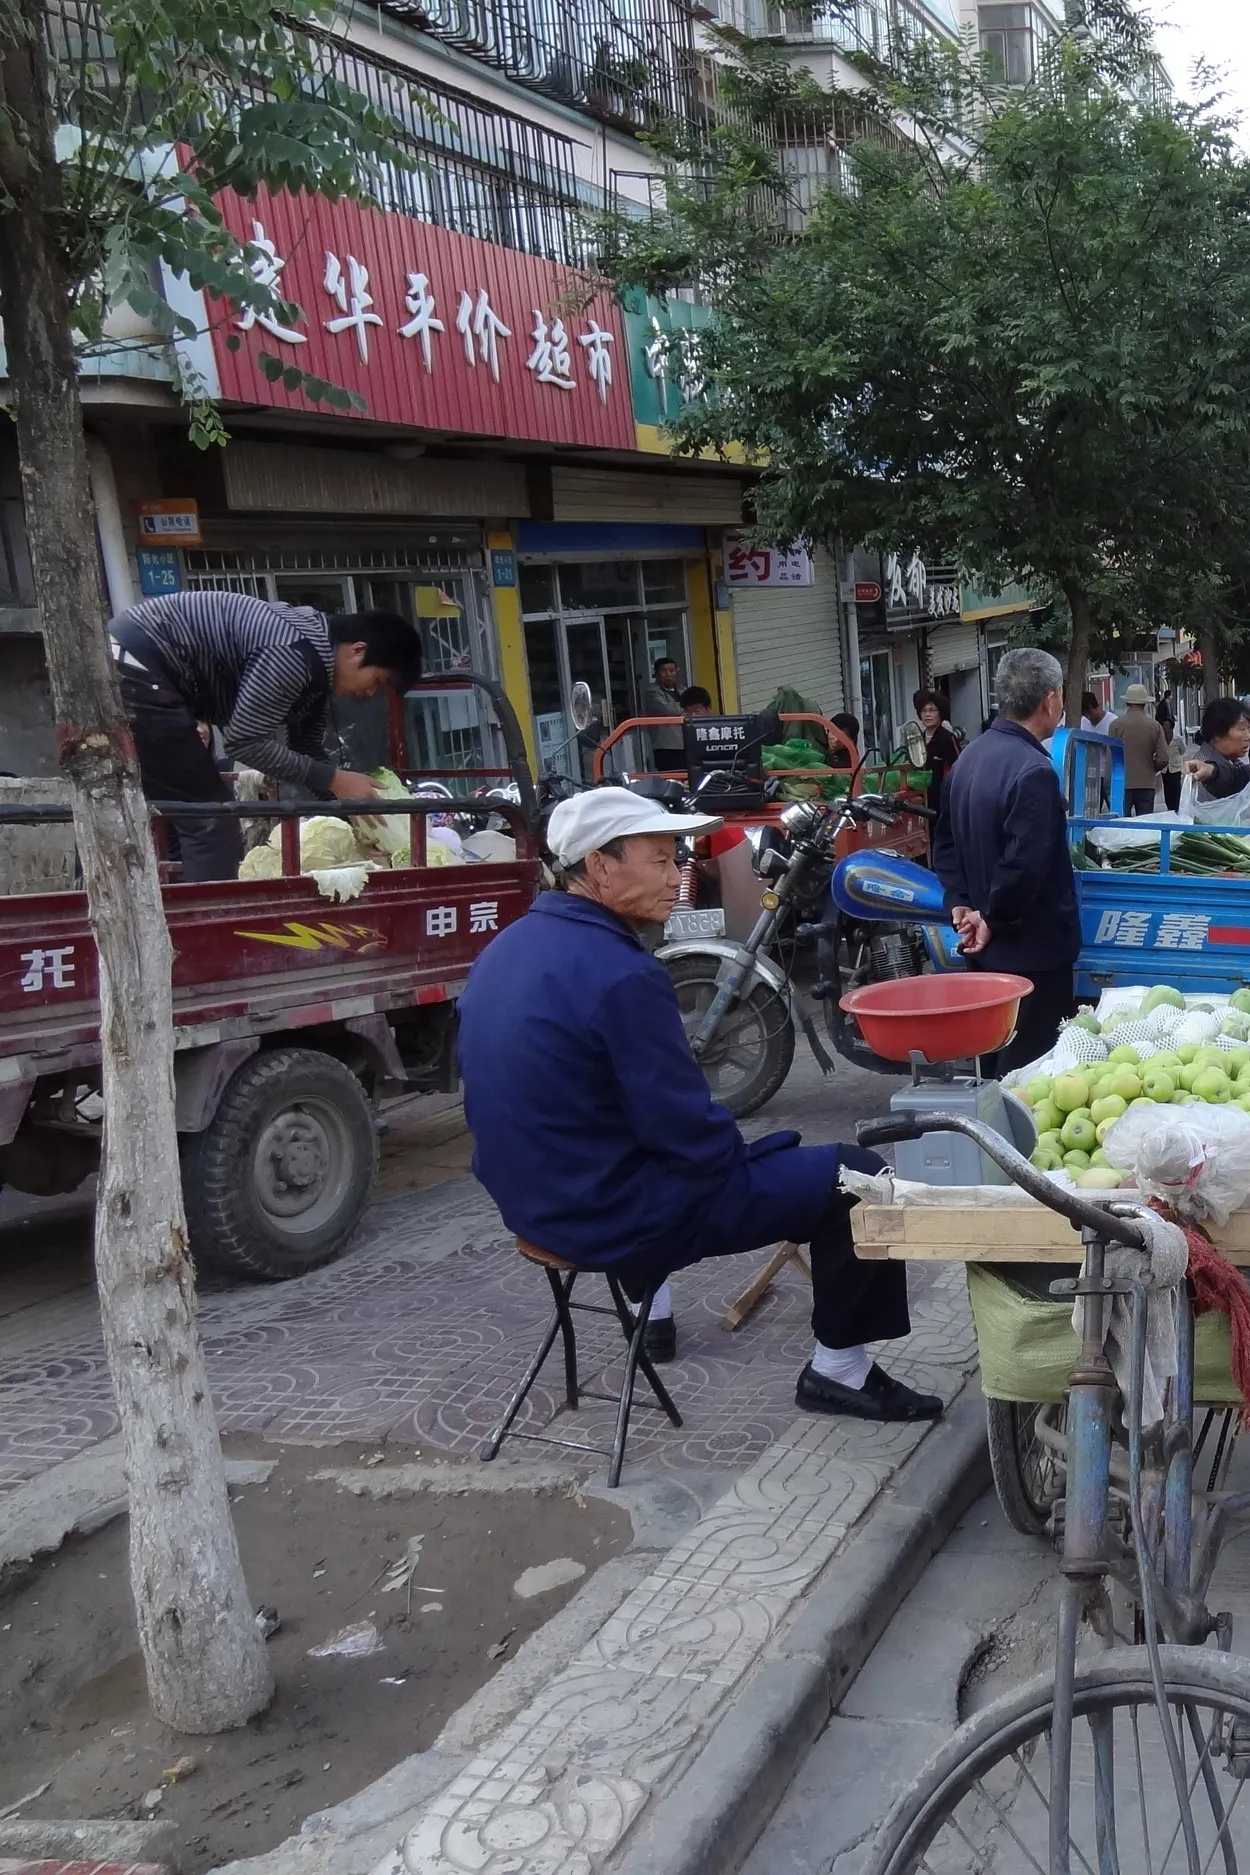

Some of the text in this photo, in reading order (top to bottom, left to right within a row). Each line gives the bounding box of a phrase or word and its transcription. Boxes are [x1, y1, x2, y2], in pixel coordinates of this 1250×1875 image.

[148, 570, 175, 587] 1-25
[696, 726, 746, 742] 隆鑫摩托
[1093, 910, 1213, 950] 隆鑫
[20, 902, 499, 993] 托 申宗
